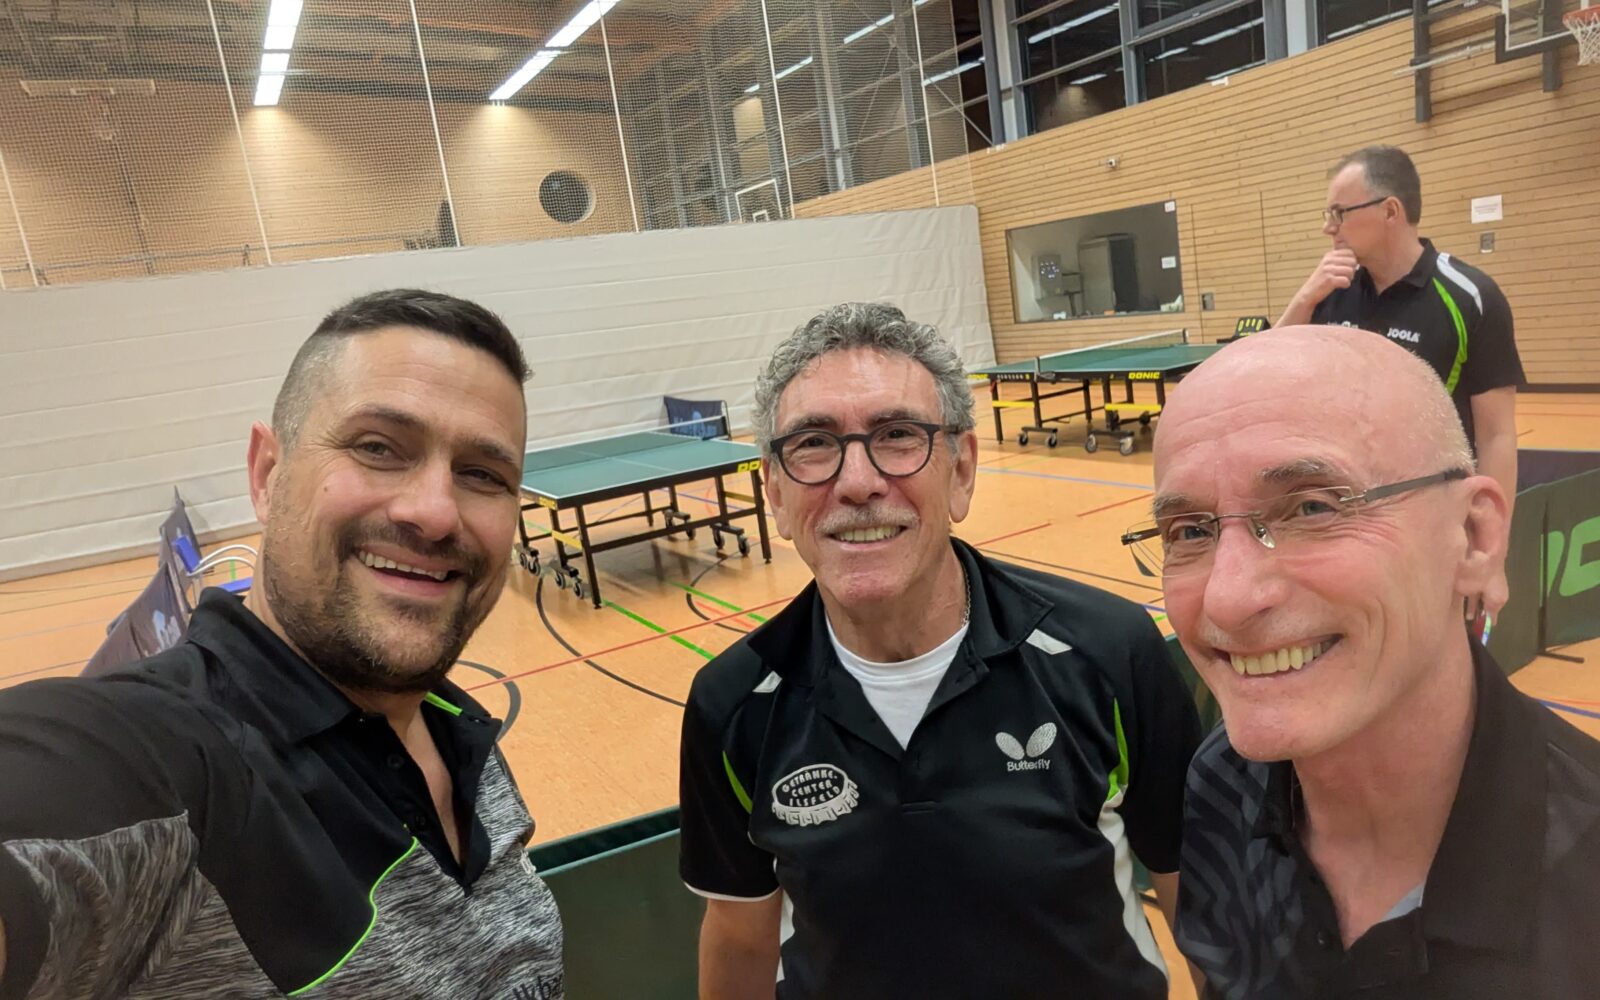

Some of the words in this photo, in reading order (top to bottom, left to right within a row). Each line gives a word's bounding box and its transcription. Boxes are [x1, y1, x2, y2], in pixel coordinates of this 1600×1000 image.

[1387, 327, 1420, 343] JOOLA
[1128, 371, 1160, 380] DONIC
[1007, 758, 1051, 772] Butterfly
[789, 785, 840, 807] ILSFELD
[791, 779, 833, 798] CENTER
